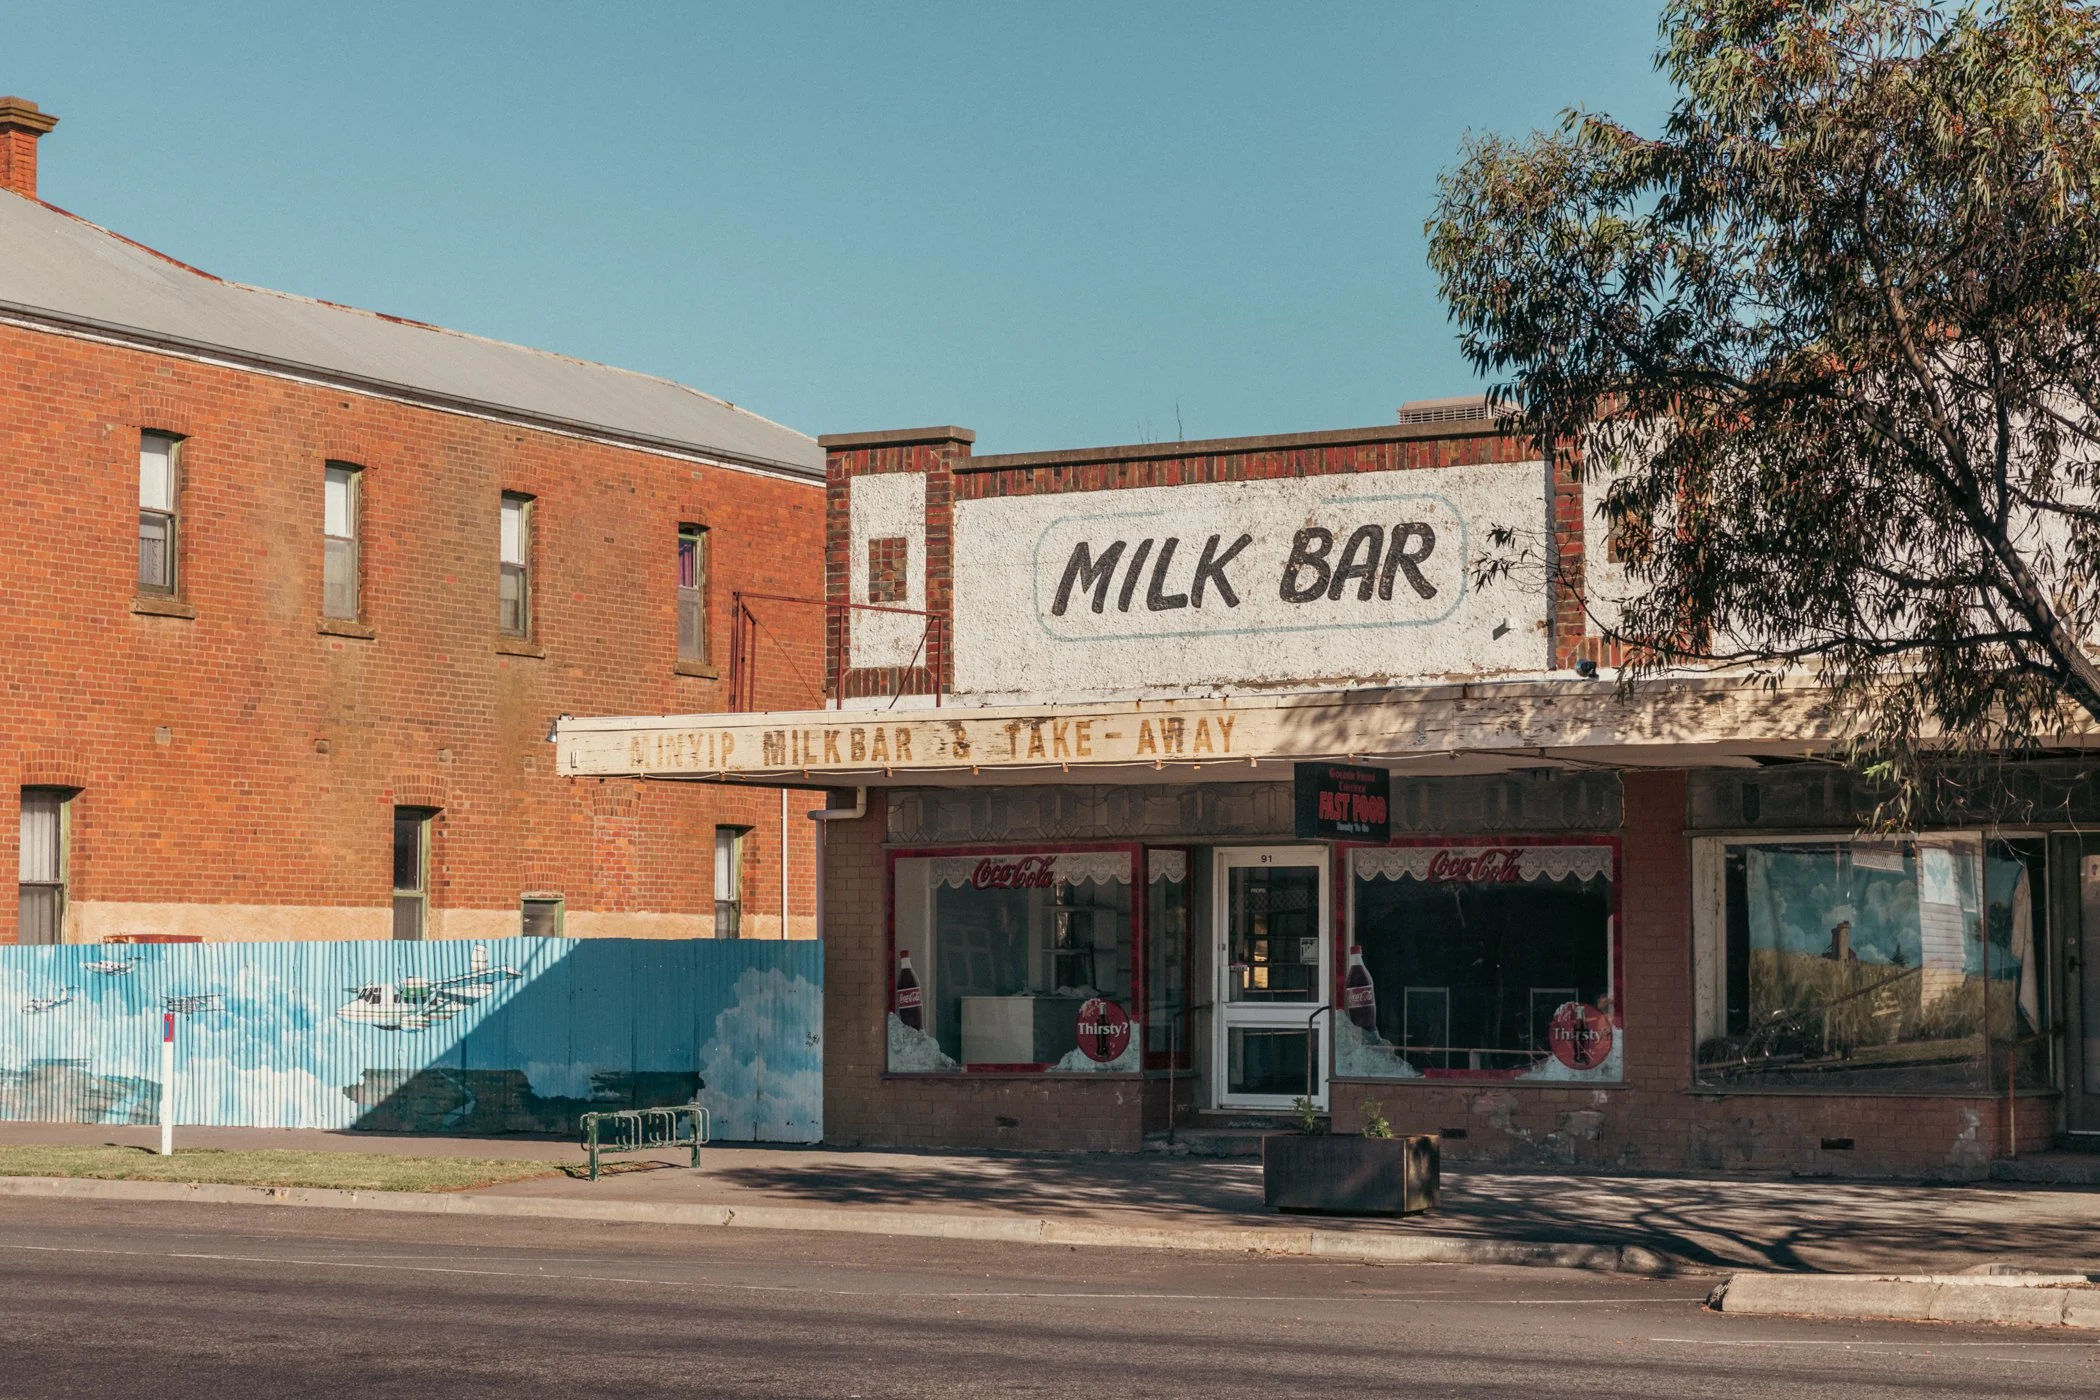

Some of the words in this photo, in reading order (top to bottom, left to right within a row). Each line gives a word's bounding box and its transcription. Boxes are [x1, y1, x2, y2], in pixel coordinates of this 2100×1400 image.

[1051, 533, 1253, 616] MILK
[1279, 521, 1438, 604] BAR
[630, 731, 735, 768] MINYIP
[1318, 791, 1350, 822] FAST
[1352, 793, 1387, 825] FOOD
[1261, 854, 1273, 864] 91
[1077, 1021, 1128, 1038] Thirsty?
